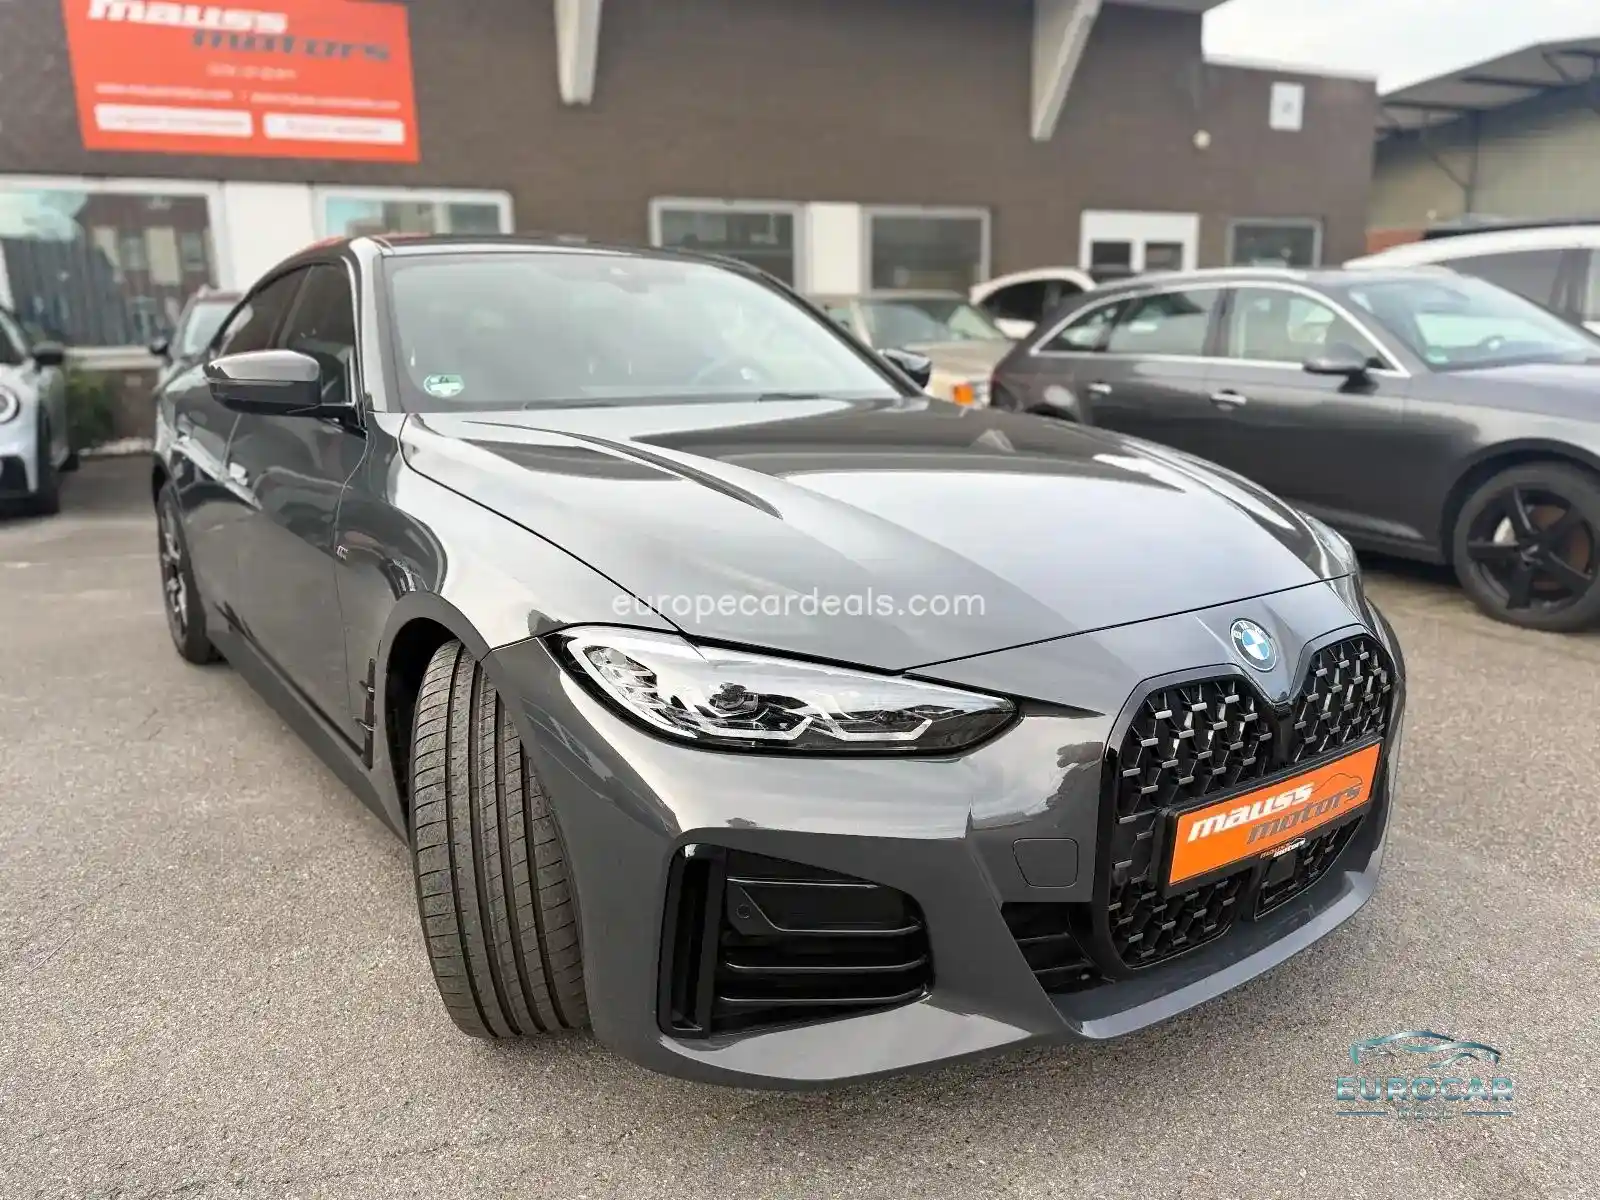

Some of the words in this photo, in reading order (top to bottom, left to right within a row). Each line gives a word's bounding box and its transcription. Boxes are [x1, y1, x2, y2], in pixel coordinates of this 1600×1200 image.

[88, 0, 287, 33] mauss
[1187, 781, 1315, 843] mauss
[1246, 785, 1361, 845] motors
